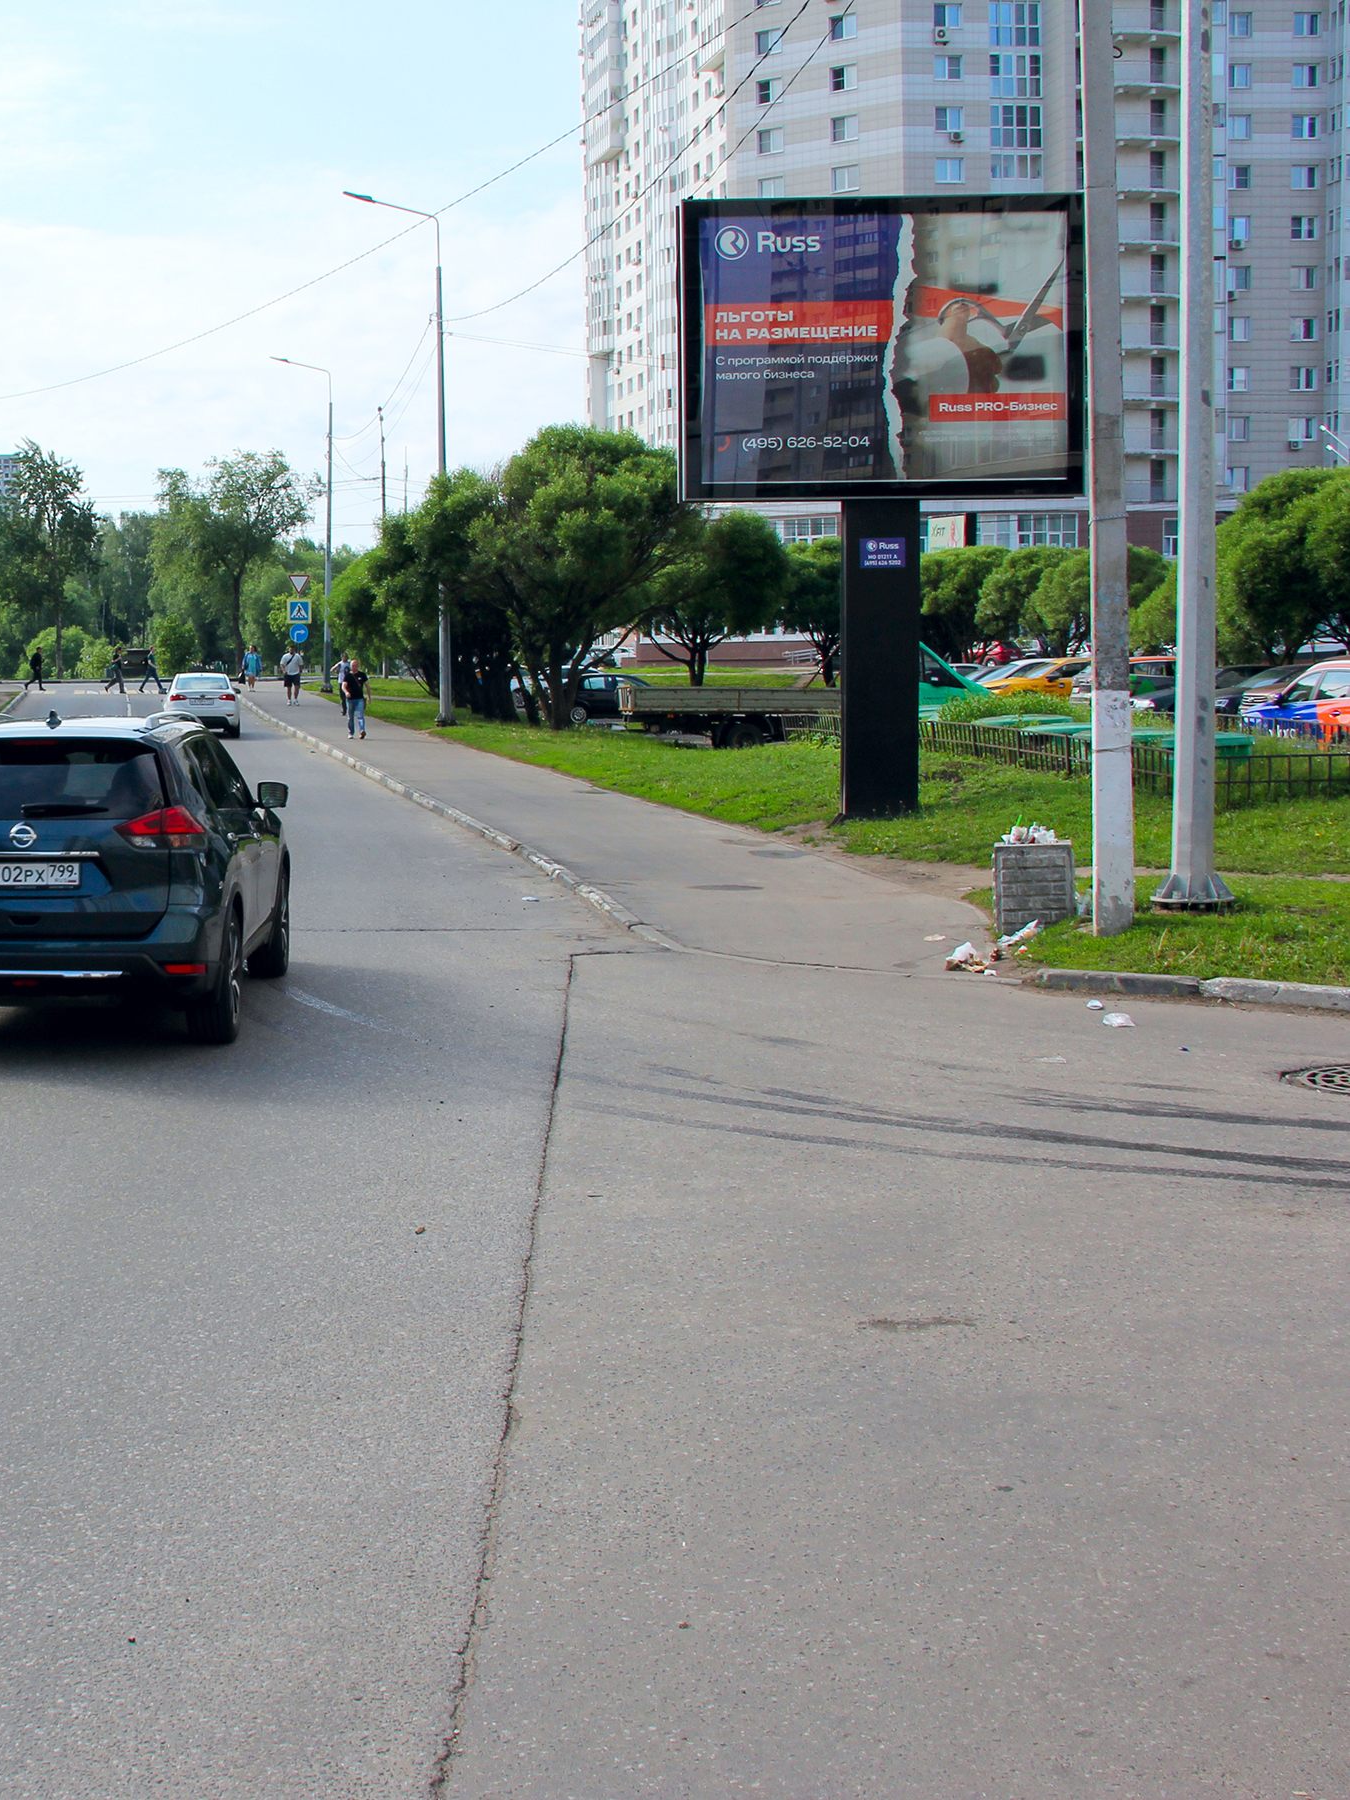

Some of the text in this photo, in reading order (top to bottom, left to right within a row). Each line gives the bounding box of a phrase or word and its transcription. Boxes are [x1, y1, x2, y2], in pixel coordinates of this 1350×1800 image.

[757, 231, 821, 253] Russ
[715, 310, 794, 323] ЛЬГОТЫ
[715, 325, 878, 340] НА РАЗМЕЩЕНИЕ
[715, 354, 878, 367] С программой поддержки
[715, 369, 815, 380] малого бизнеса
[939, 401, 1058, 412] Russ PRO-Бизнес
[742, 436, 870, 451] (495) 626-52-04
[879, 541, 900, 550] Russ
